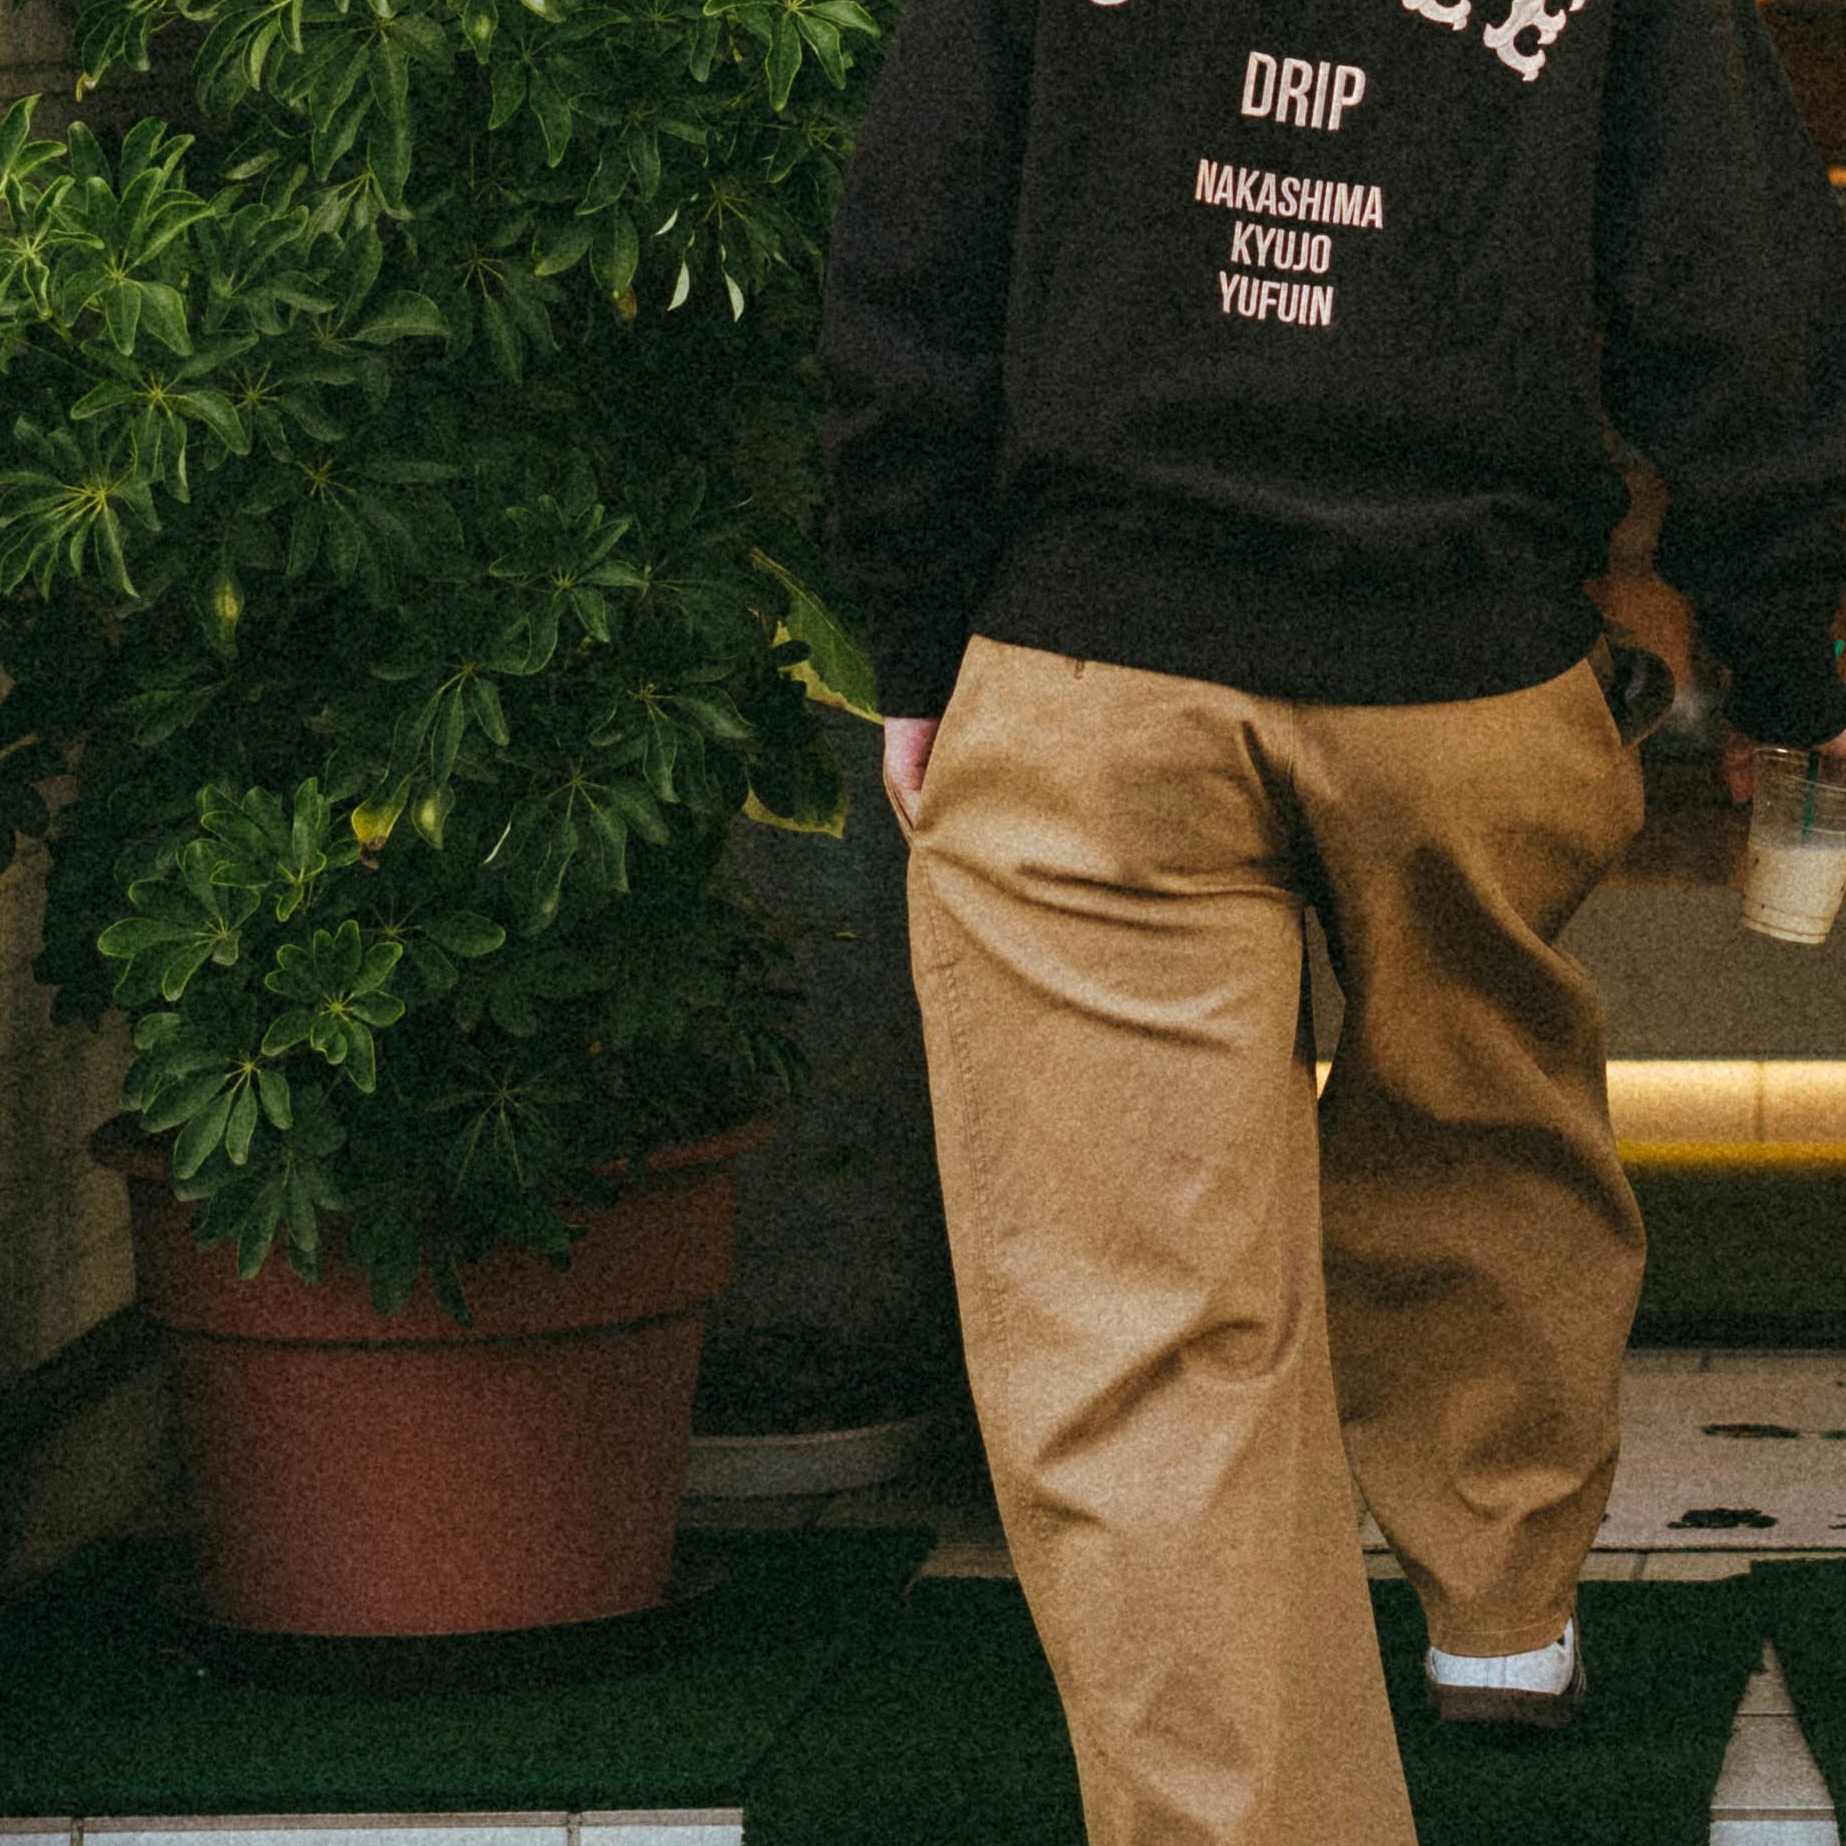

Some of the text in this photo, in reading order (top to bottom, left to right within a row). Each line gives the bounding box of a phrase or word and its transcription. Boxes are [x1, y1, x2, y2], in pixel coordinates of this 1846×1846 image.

[1240, 49, 1367, 132] DRIP
[1194, 158, 1384, 230] NAKASHIMA
[1230, 220, 1333, 274] KYUJO
[1218, 270, 1335, 327] YUFUIN
